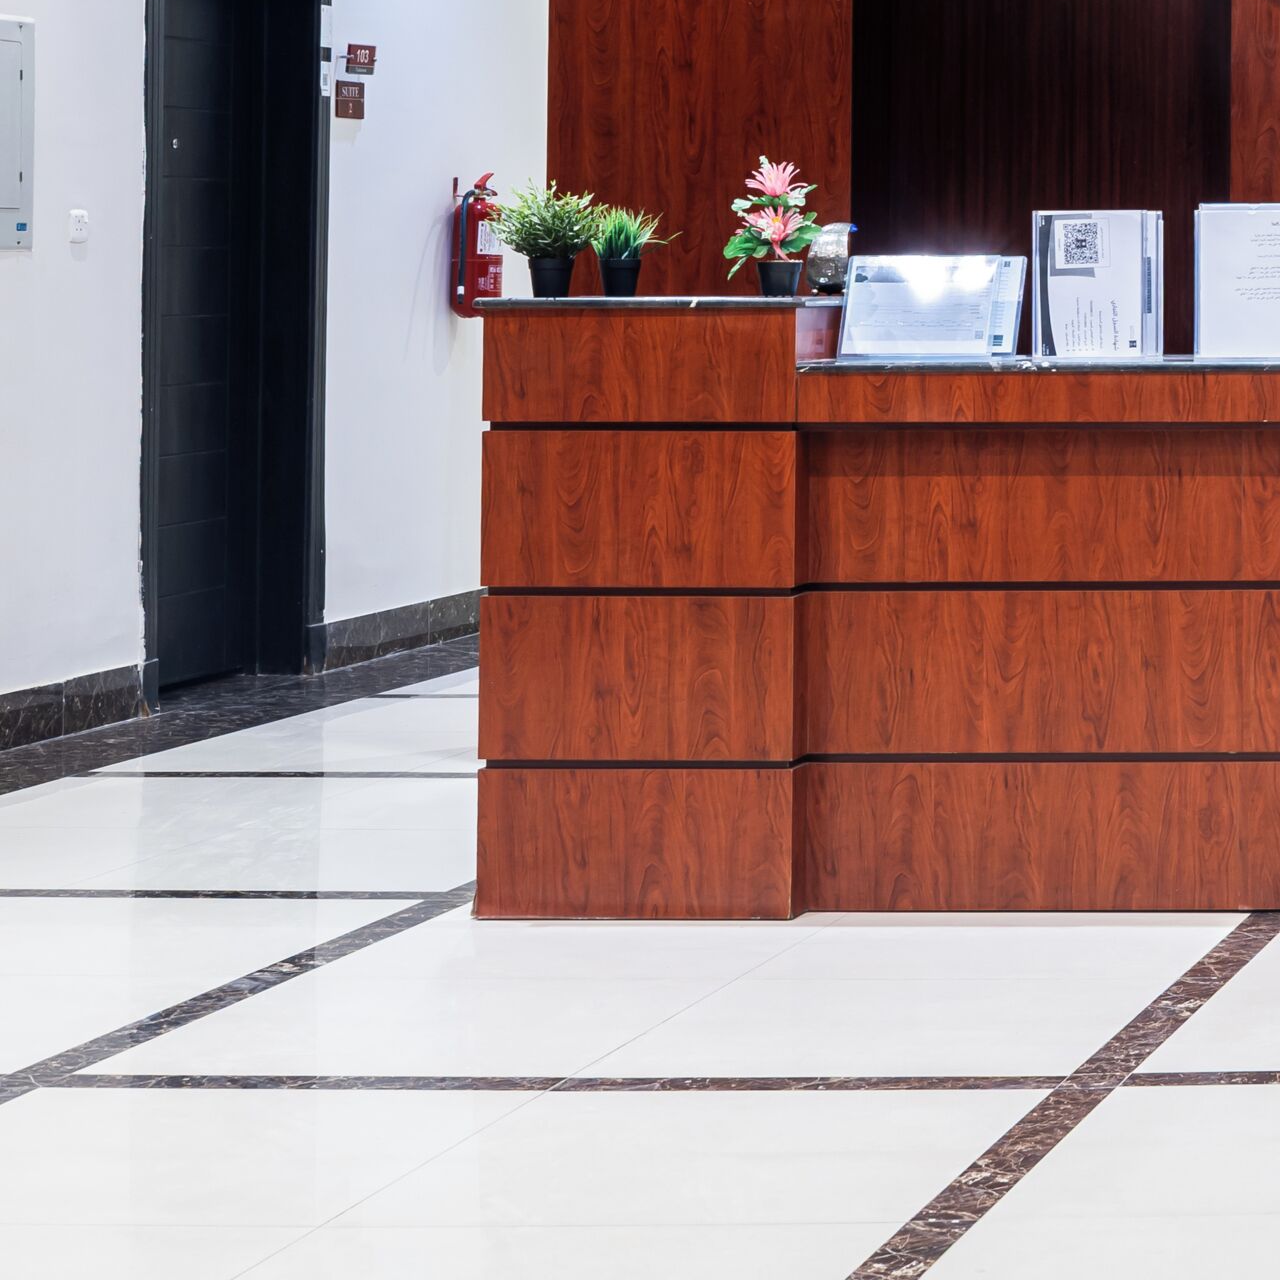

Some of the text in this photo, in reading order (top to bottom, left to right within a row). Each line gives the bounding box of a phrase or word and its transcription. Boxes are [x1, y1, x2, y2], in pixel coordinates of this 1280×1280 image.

[357, 49, 369, 63] 103
[342, 87, 359, 97] SUITE
[349, 103, 353, 113] 2
